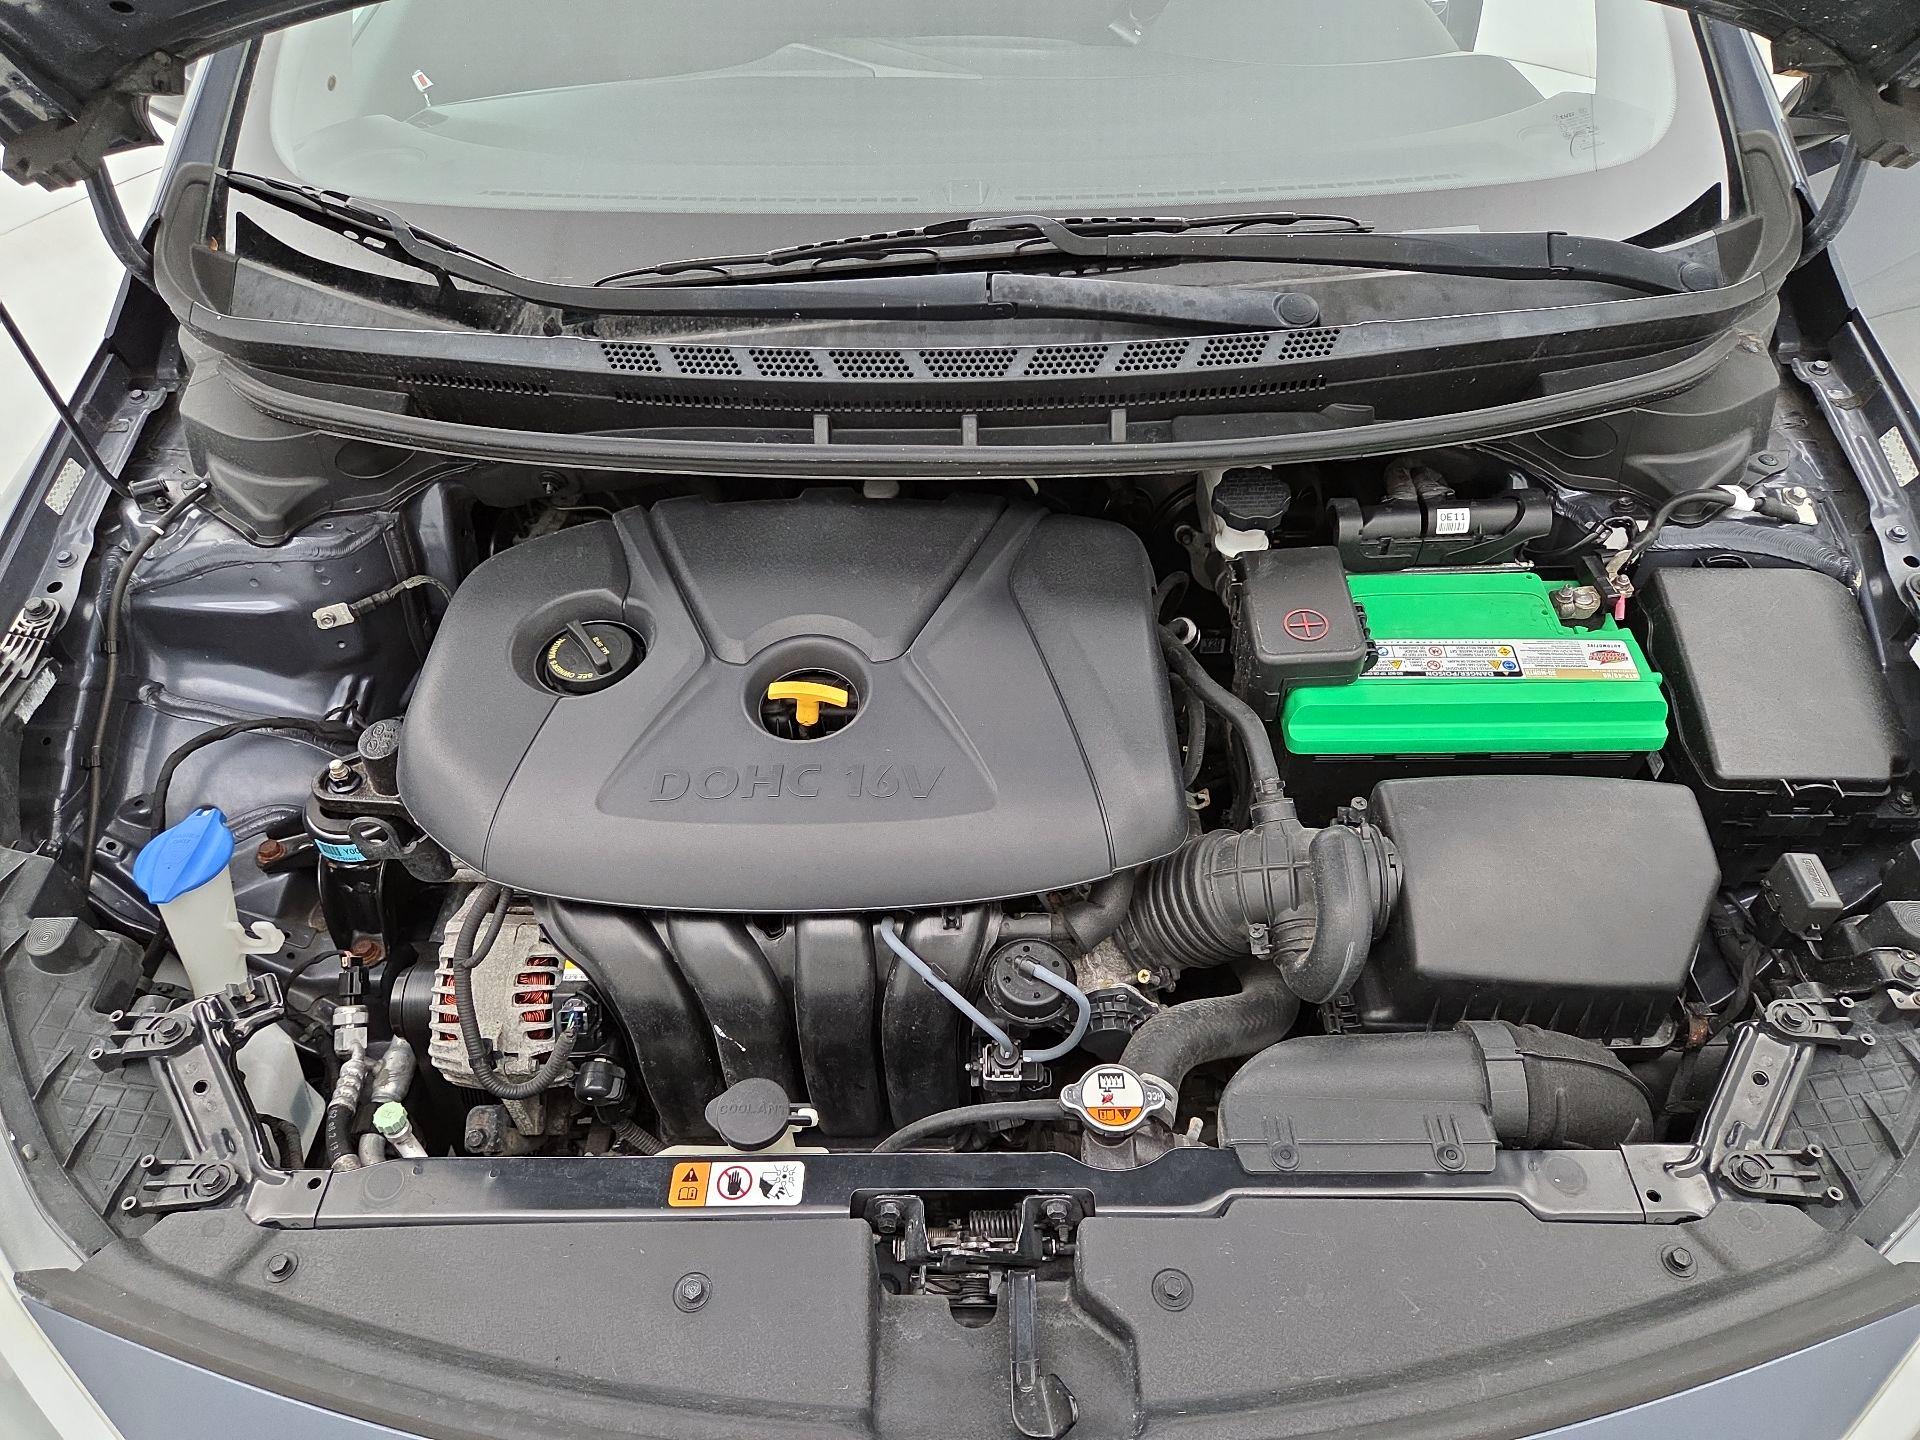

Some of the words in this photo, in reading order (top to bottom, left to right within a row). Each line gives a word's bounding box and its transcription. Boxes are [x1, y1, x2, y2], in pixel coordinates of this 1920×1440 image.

[649, 763, 822, 803] DOHC
[845, 762, 947, 800] 16V
[1146, 1091, 1163, 1101] HCC
[720, 1103, 785, 1115] COOLANT
